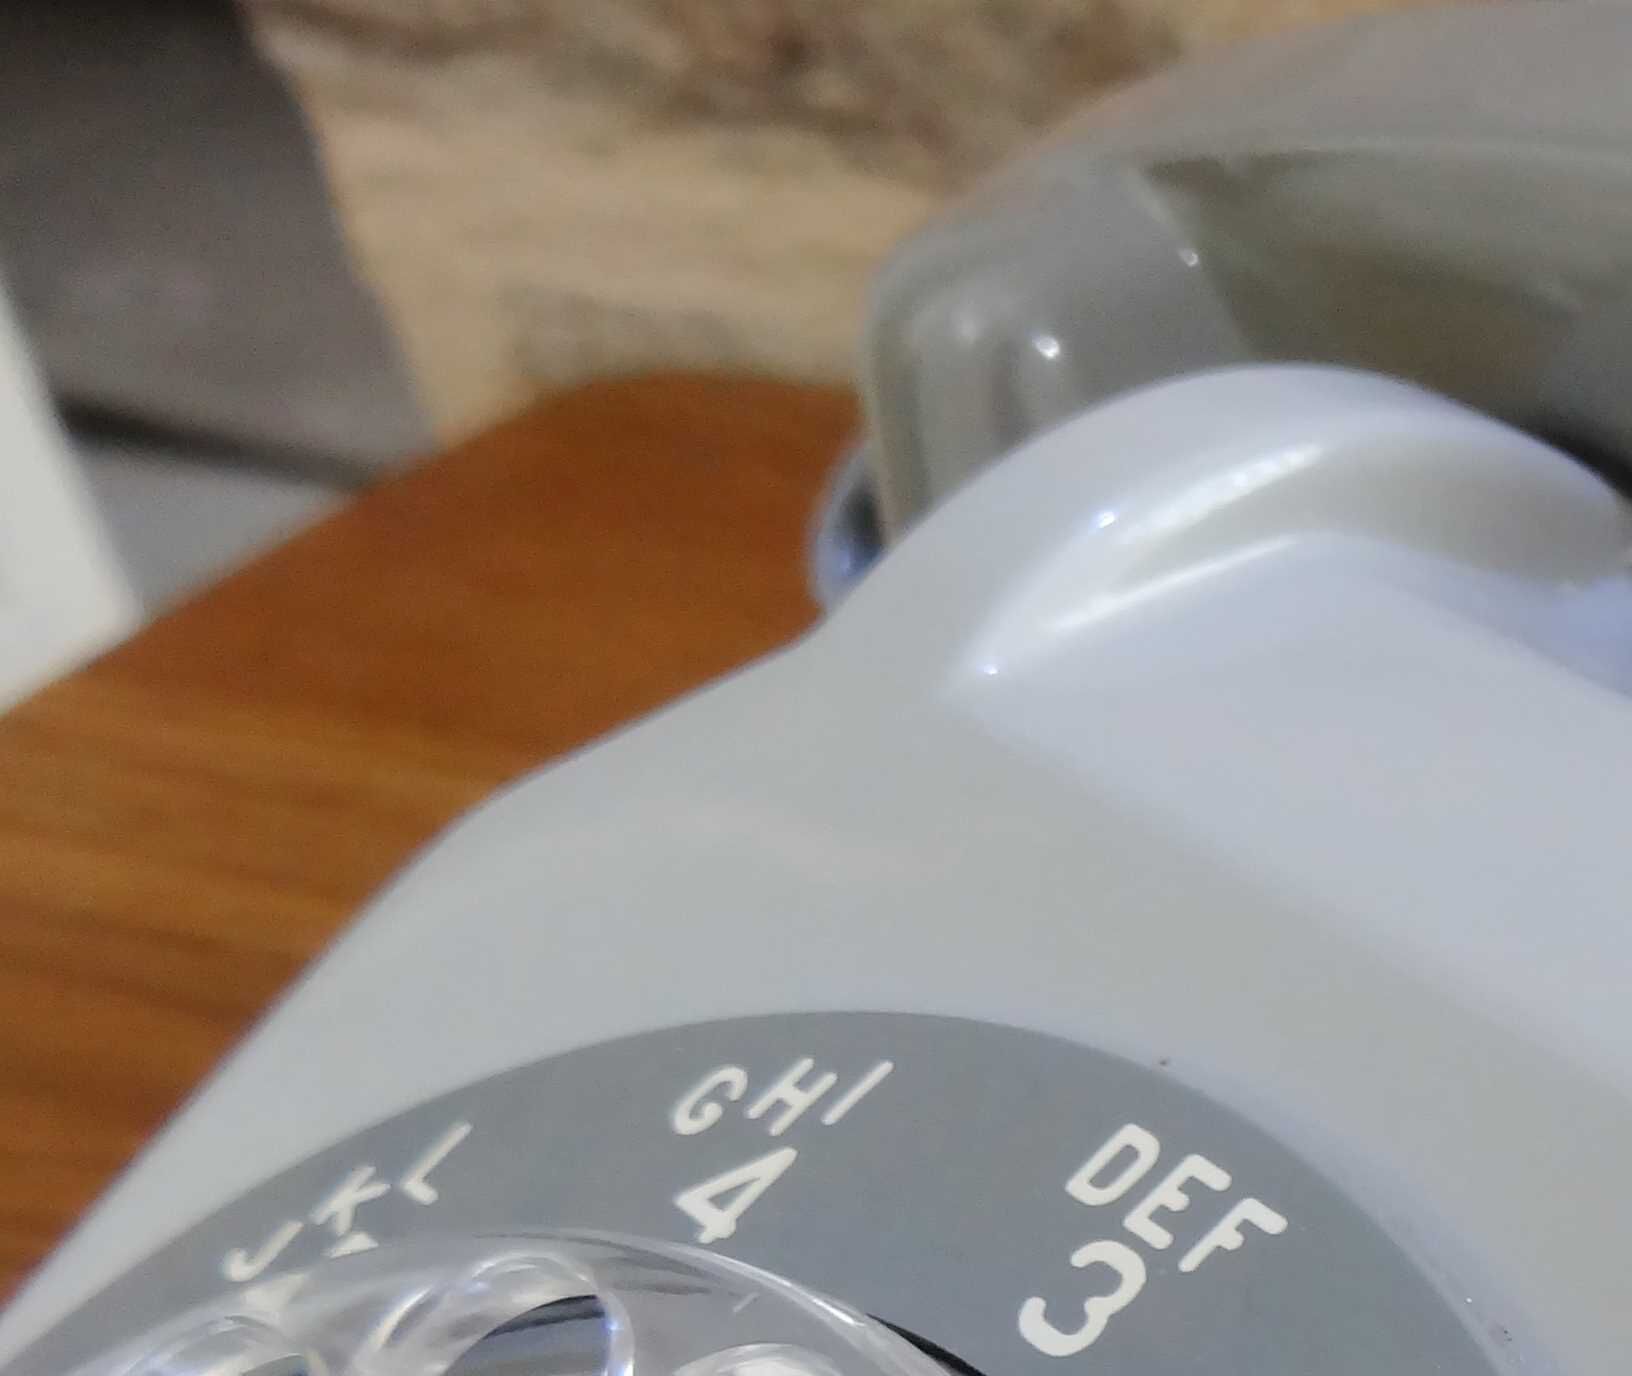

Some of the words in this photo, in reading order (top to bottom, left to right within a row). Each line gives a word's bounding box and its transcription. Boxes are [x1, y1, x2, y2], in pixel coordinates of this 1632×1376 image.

[670, 1056, 894, 1137] GHI
[672, 1145, 799, 1245] 4
[1063, 1123, 1289, 1273] DEF
[1017, 1239, 1147, 1358] 3
